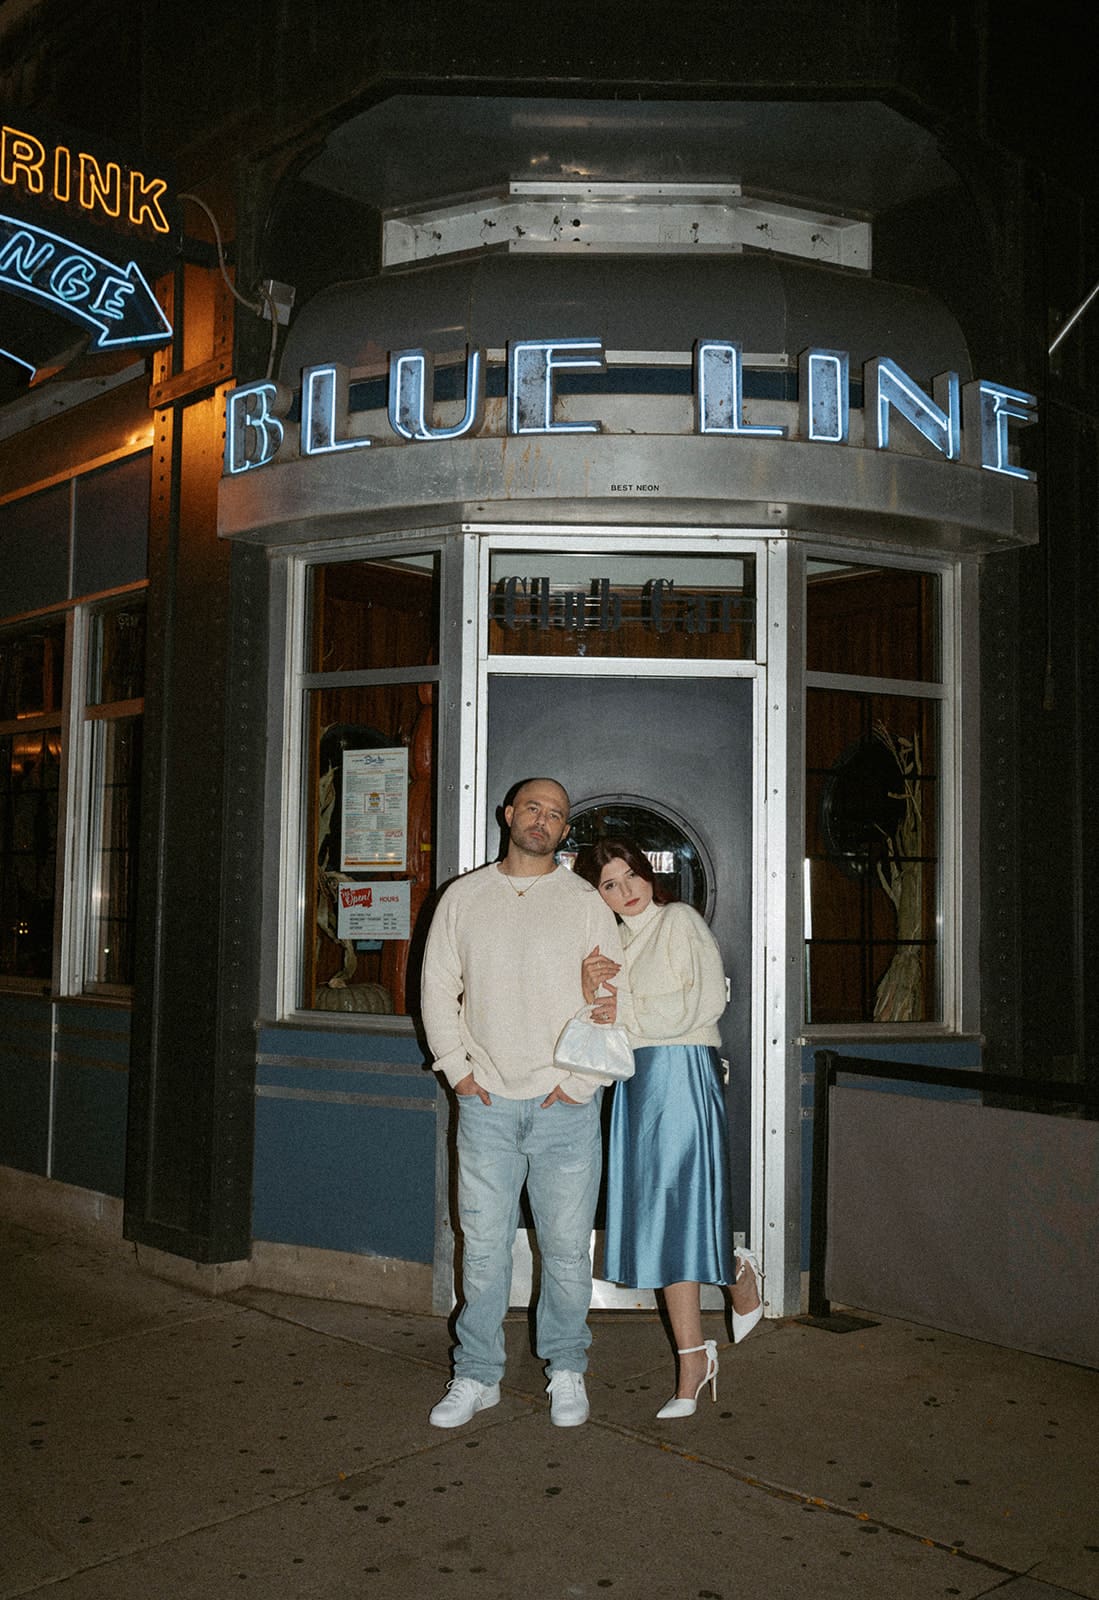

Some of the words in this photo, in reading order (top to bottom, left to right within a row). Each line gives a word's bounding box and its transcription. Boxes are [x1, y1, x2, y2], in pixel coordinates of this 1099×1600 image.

[0, 125, 170, 233] RINK
[224, 337, 603, 476] BLUE
[695, 338, 1038, 480] LINE
[503, 576, 622, 632] Club
[651, 578, 740, 633] Car
